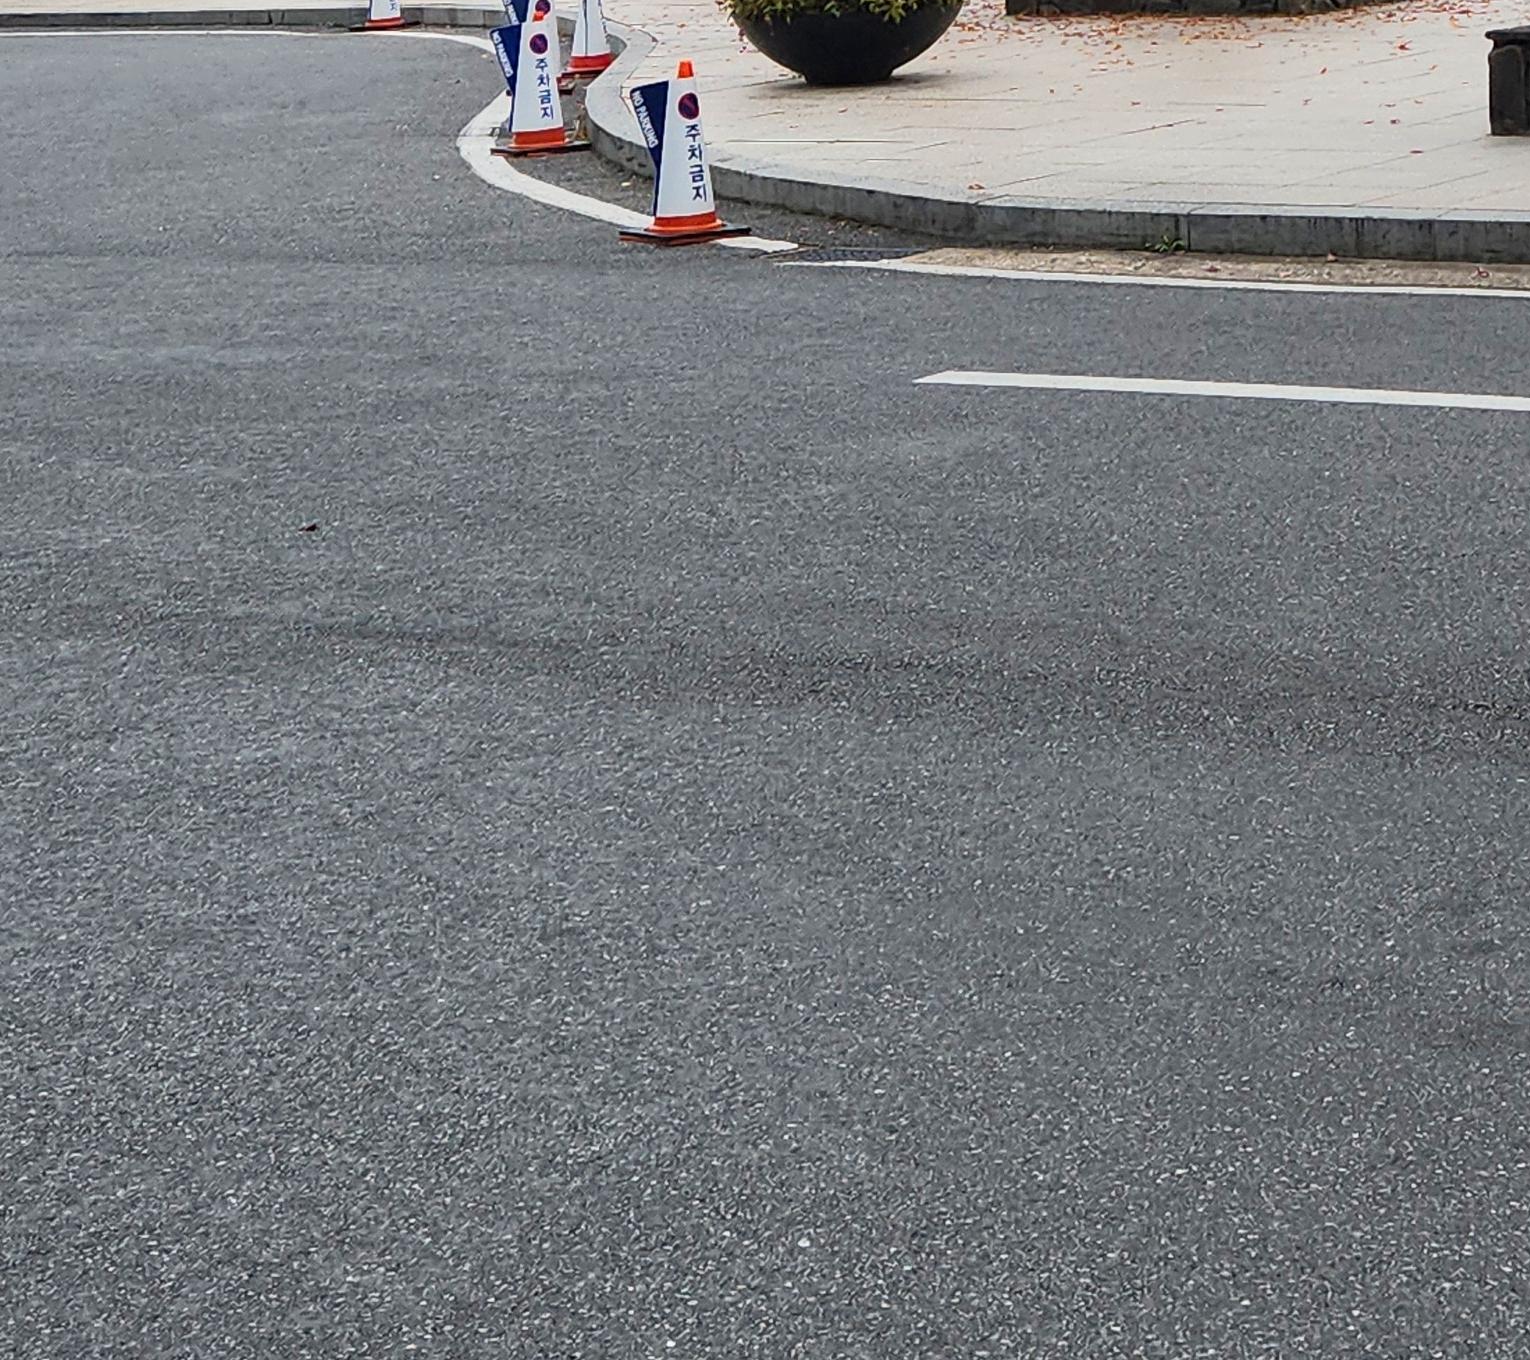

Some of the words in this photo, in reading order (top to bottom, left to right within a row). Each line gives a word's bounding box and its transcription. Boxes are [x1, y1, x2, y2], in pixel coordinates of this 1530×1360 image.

[534, 57, 554, 120] 주차금지
[631, 90, 644, 107] NO
[636, 104, 660, 150] PARKING
[684, 123, 707, 202] 주차금지
